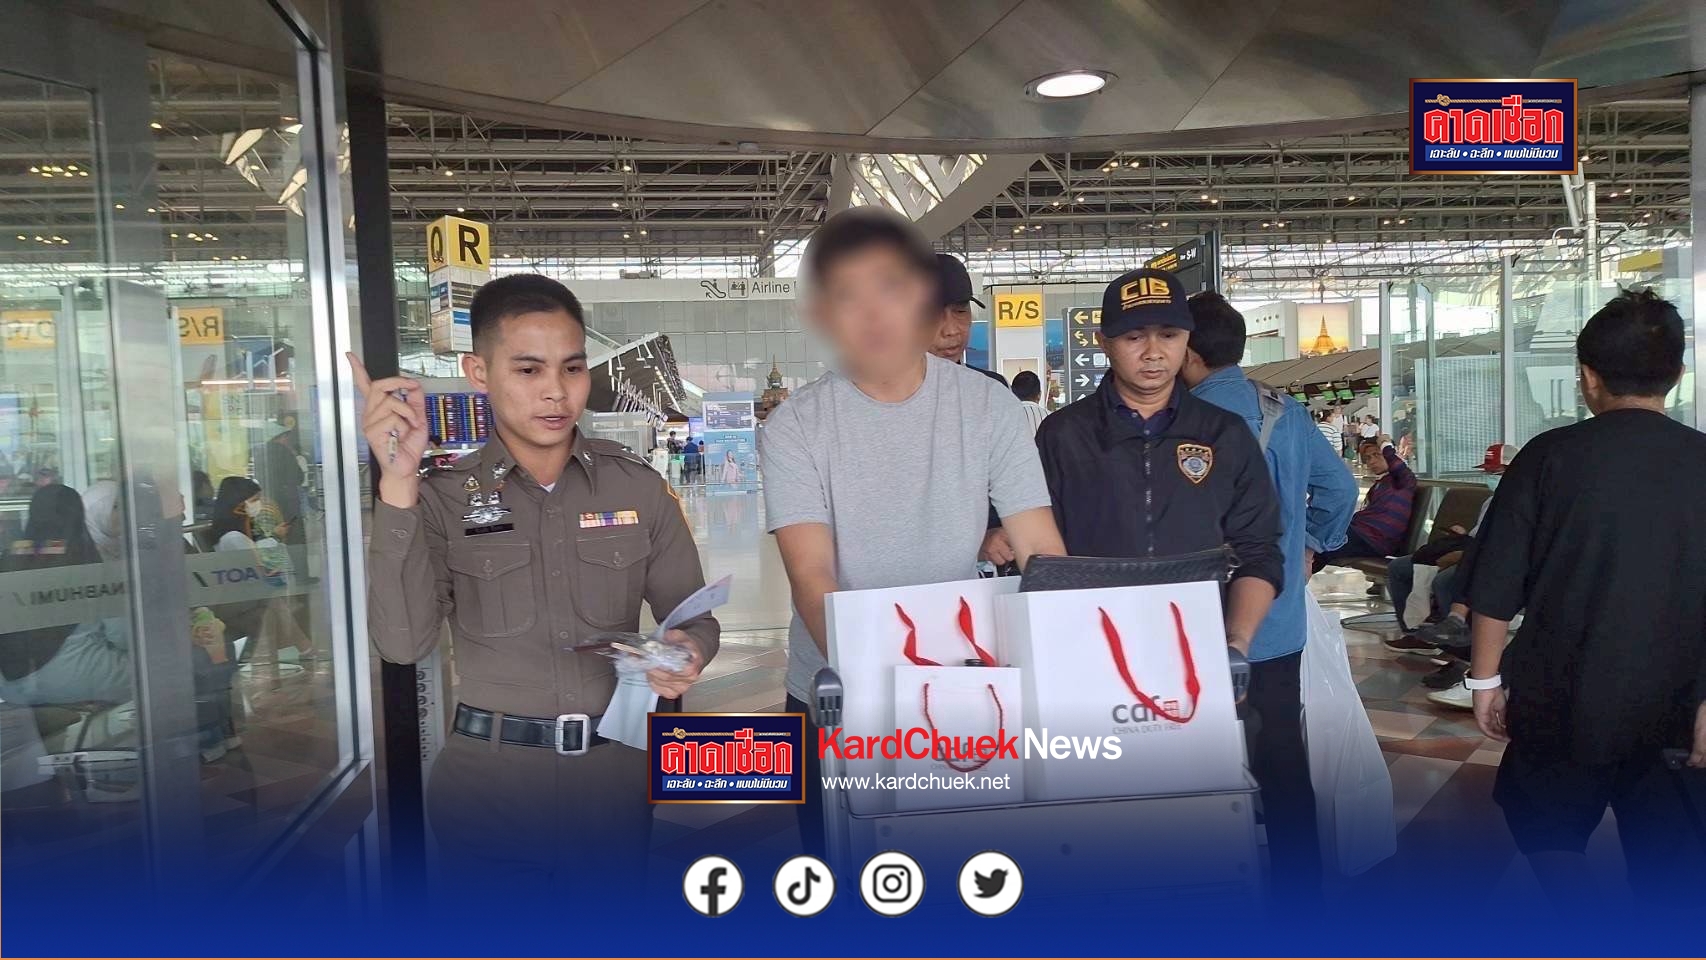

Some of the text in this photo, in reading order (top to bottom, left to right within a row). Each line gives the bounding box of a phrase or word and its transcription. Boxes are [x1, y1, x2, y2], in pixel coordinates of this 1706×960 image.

[431, 226, 444, 263] Q
[458, 224, 482, 265] R
[751, 281, 790, 294] Airline
[1121, 277, 1170, 300] CIB
[998, 300, 1040, 320] R/S
